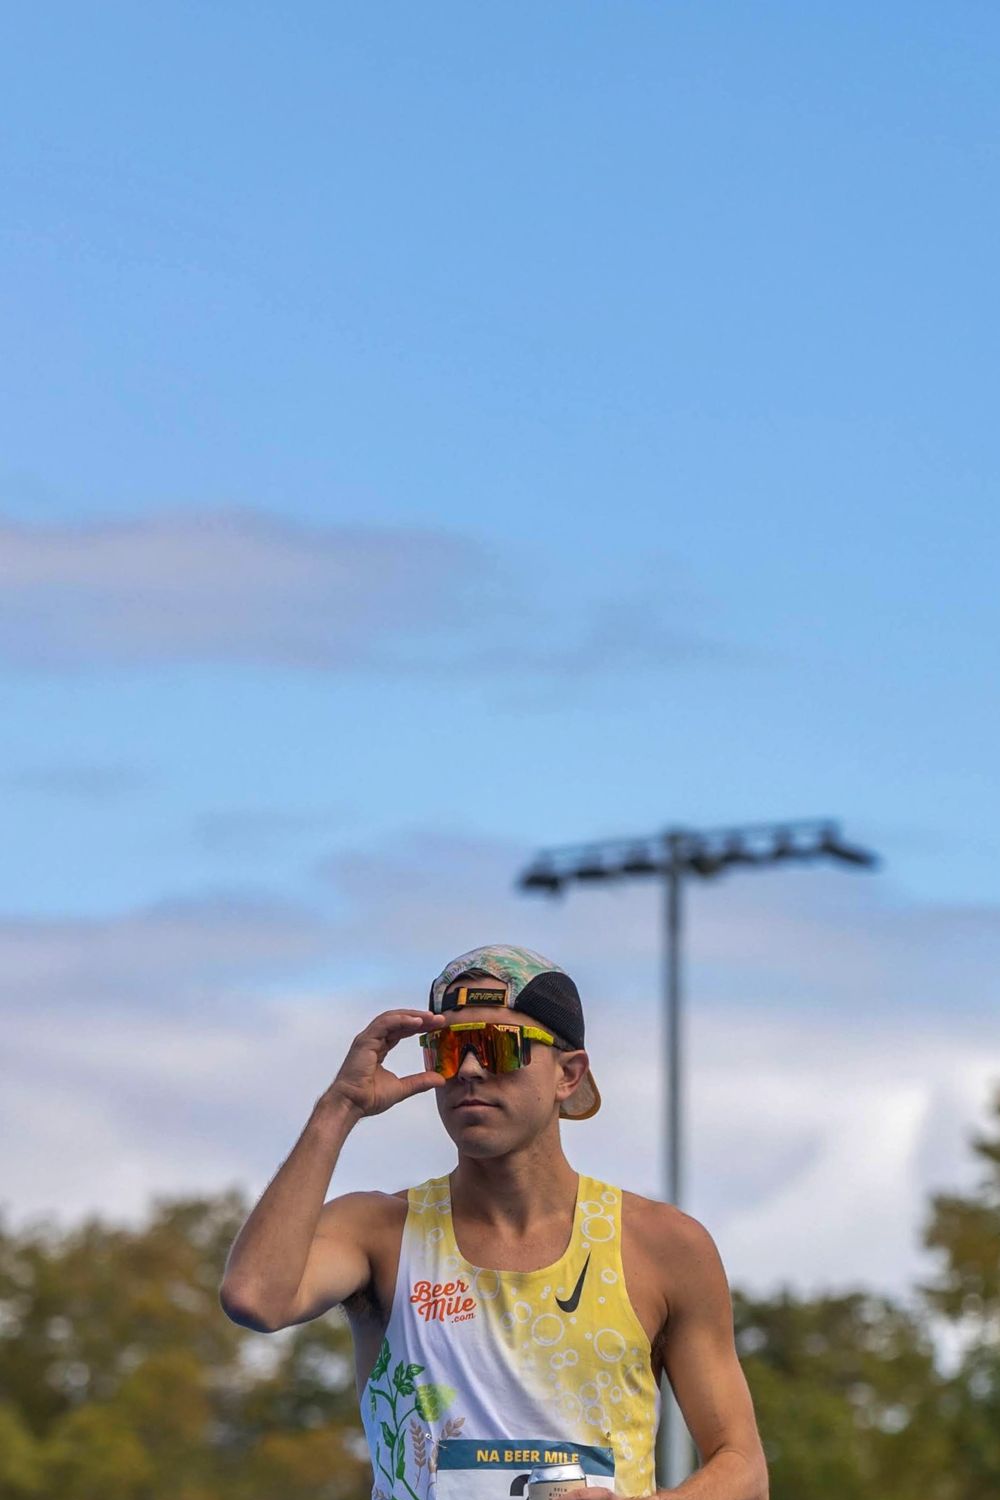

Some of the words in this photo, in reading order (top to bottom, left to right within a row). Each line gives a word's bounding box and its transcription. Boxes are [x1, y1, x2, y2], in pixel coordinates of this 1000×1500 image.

[410, 1279, 469, 1303] Beer
[417, 1295, 476, 1322] Mile
[476, 1449, 500, 1463] NA
[504, 1449, 540, 1463] BEER
[544, 1450, 579, 1465] MILE
